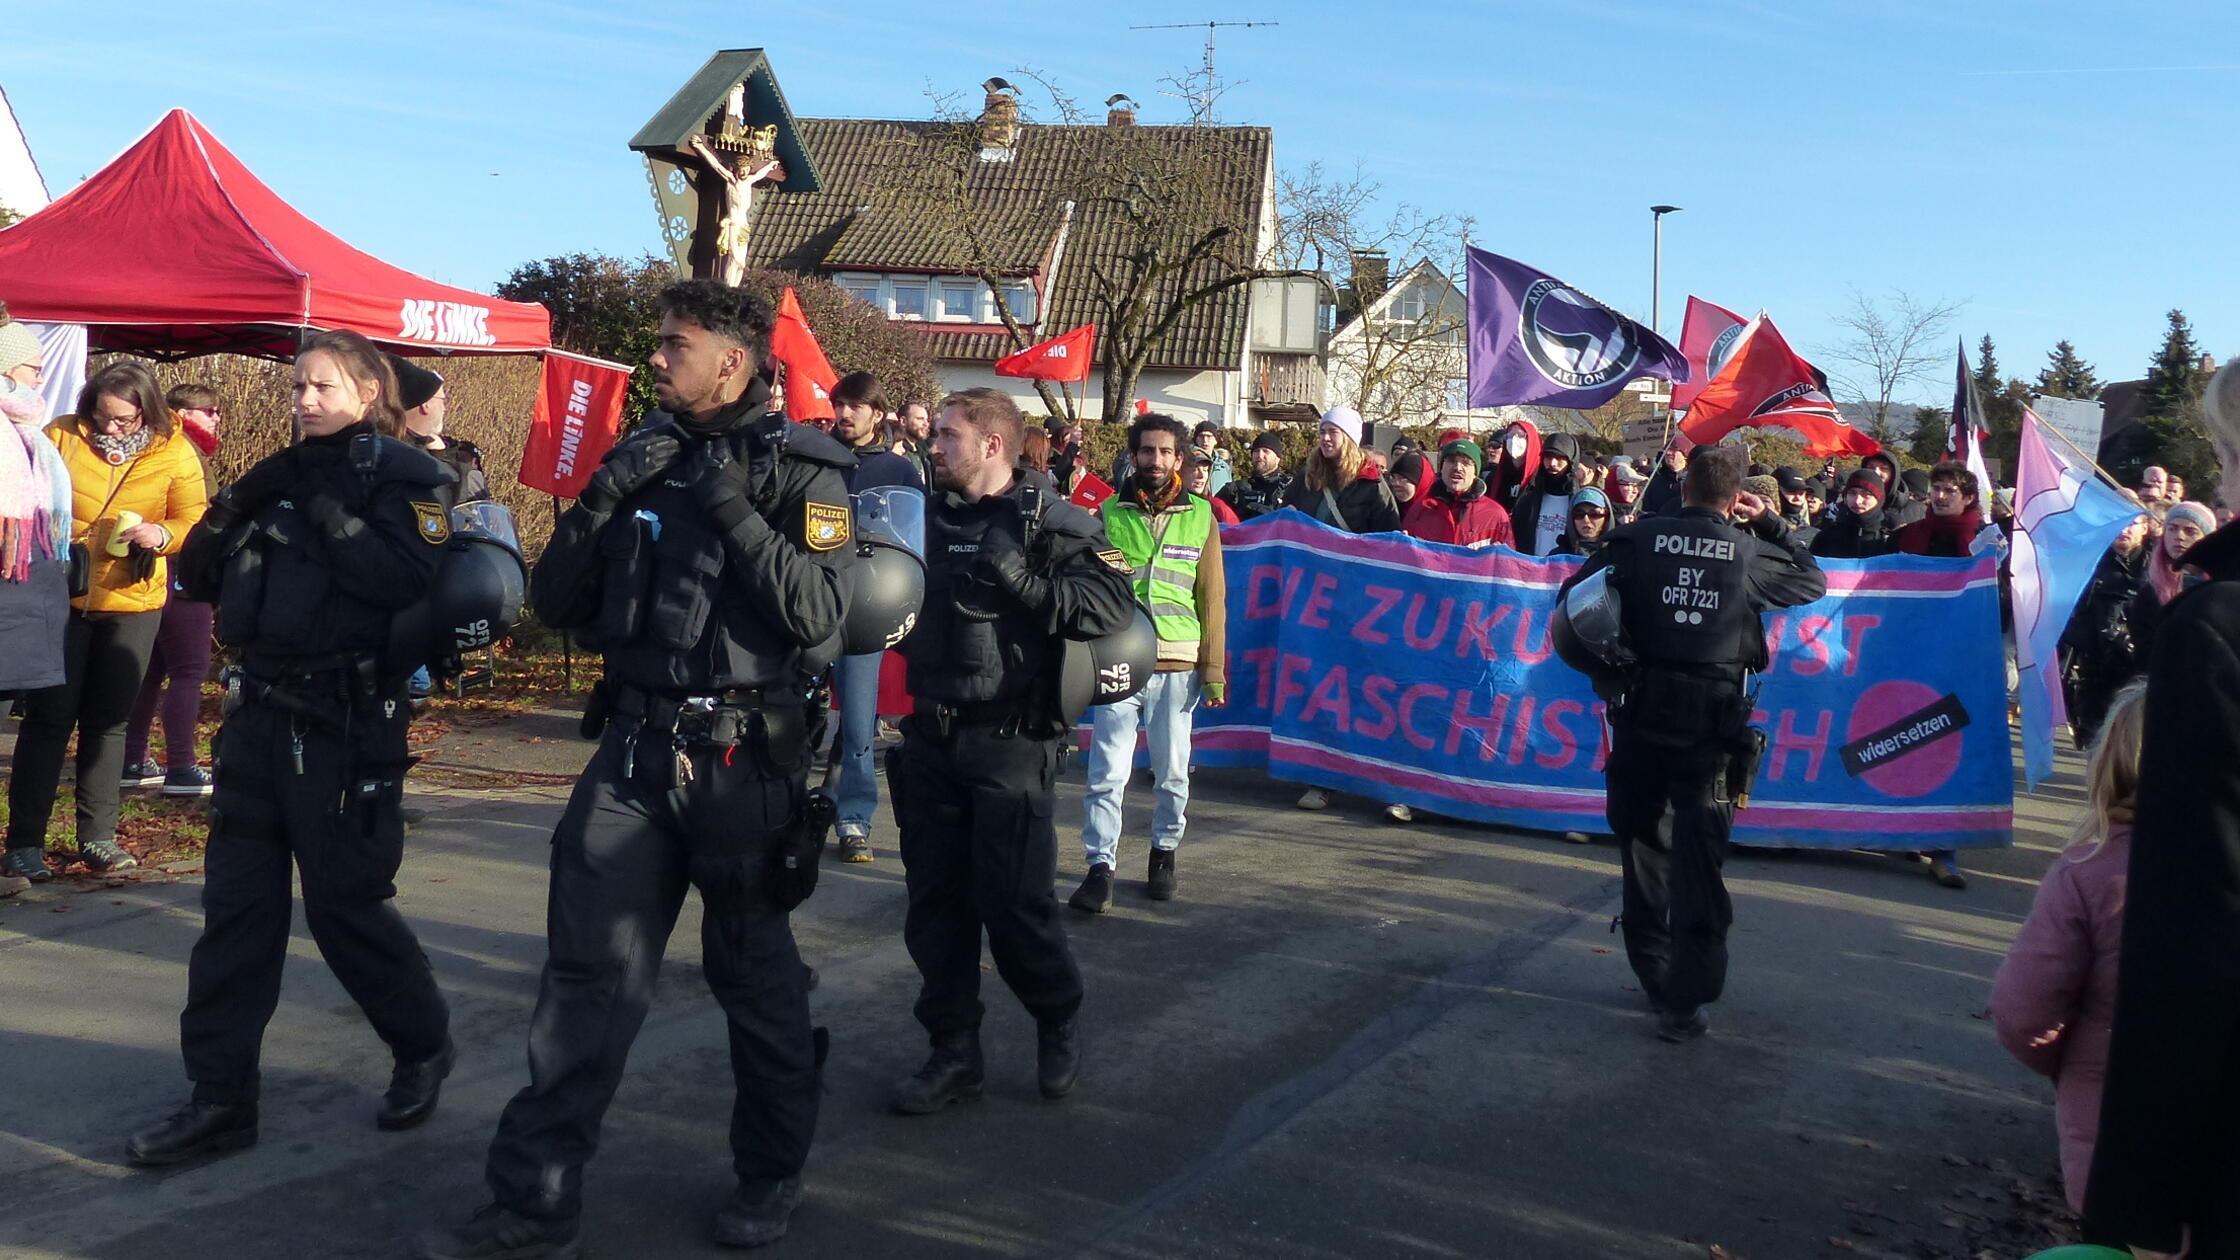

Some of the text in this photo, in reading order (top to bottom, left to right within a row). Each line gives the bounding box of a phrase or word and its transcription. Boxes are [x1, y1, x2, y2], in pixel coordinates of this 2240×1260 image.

[398, 299, 435, 341] DIE
[1553, 368, 1606, 386] AKTION
[554, 379, 593, 480] DIE LINKE.
[810, 507, 845, 520] POLIZEI
[1654, 534, 1736, 561] POLIZEI
[1678, 567, 1705, 587] BY
[1662, 586, 1719, 610] OFR 7221
[475, 619, 490, 646] OFR
[1245, 564, 1882, 678] DIE ZUKU IST
[455, 622, 477, 649] 72
[1100, 664, 1119, 694] 72
[1118, 662, 1131, 692] OFR
